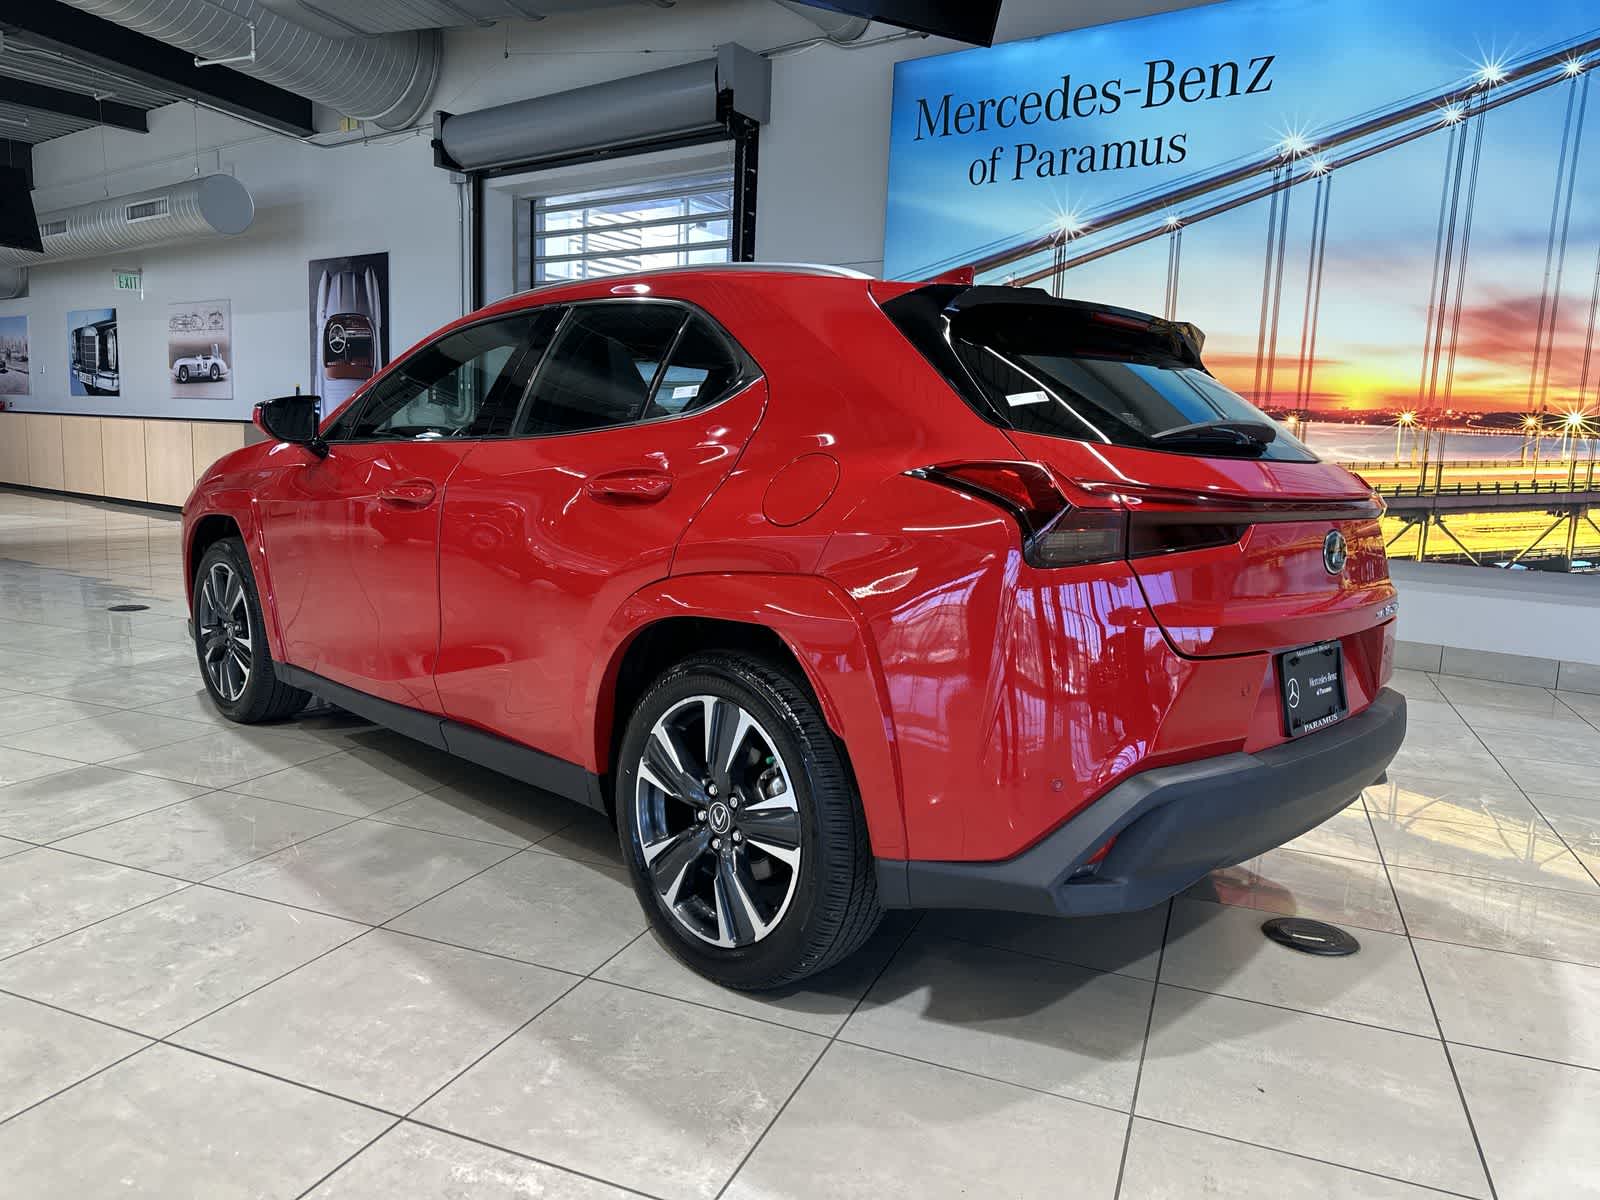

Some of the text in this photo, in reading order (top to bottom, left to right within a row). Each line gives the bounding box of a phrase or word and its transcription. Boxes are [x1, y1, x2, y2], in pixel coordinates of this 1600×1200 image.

[913, 54, 1276, 141] Mercedes-Benz
[968, 132, 1188, 186] of Paramus
[119, 275, 137, 289] EXIT
[1304, 713, 1338, 733] PARAMUS
